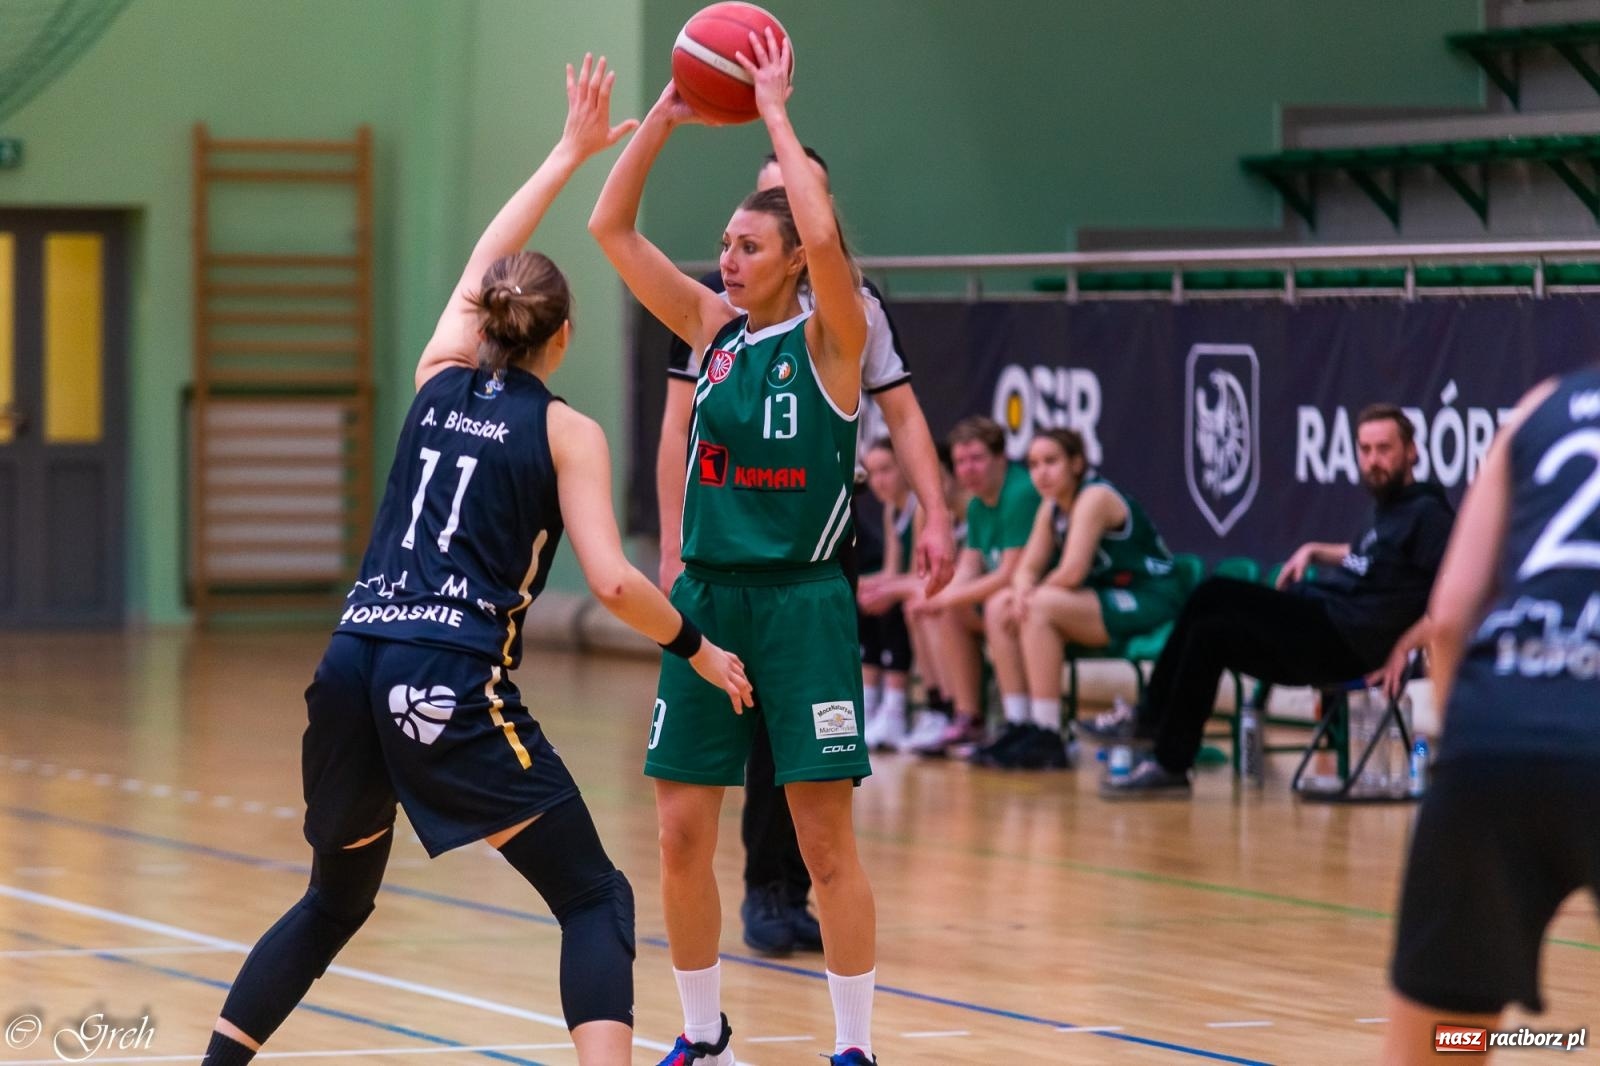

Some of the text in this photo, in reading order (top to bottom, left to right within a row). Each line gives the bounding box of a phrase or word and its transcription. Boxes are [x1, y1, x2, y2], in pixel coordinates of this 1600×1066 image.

[420, 407, 437, 427] A.
[763, 392, 798, 440] 13
[1296, 378, 1522, 488] RABÓR
[734, 466, 807, 488] KAMAN
[401, 447, 478, 553] 11
[822, 744, 856, 754] COLO
